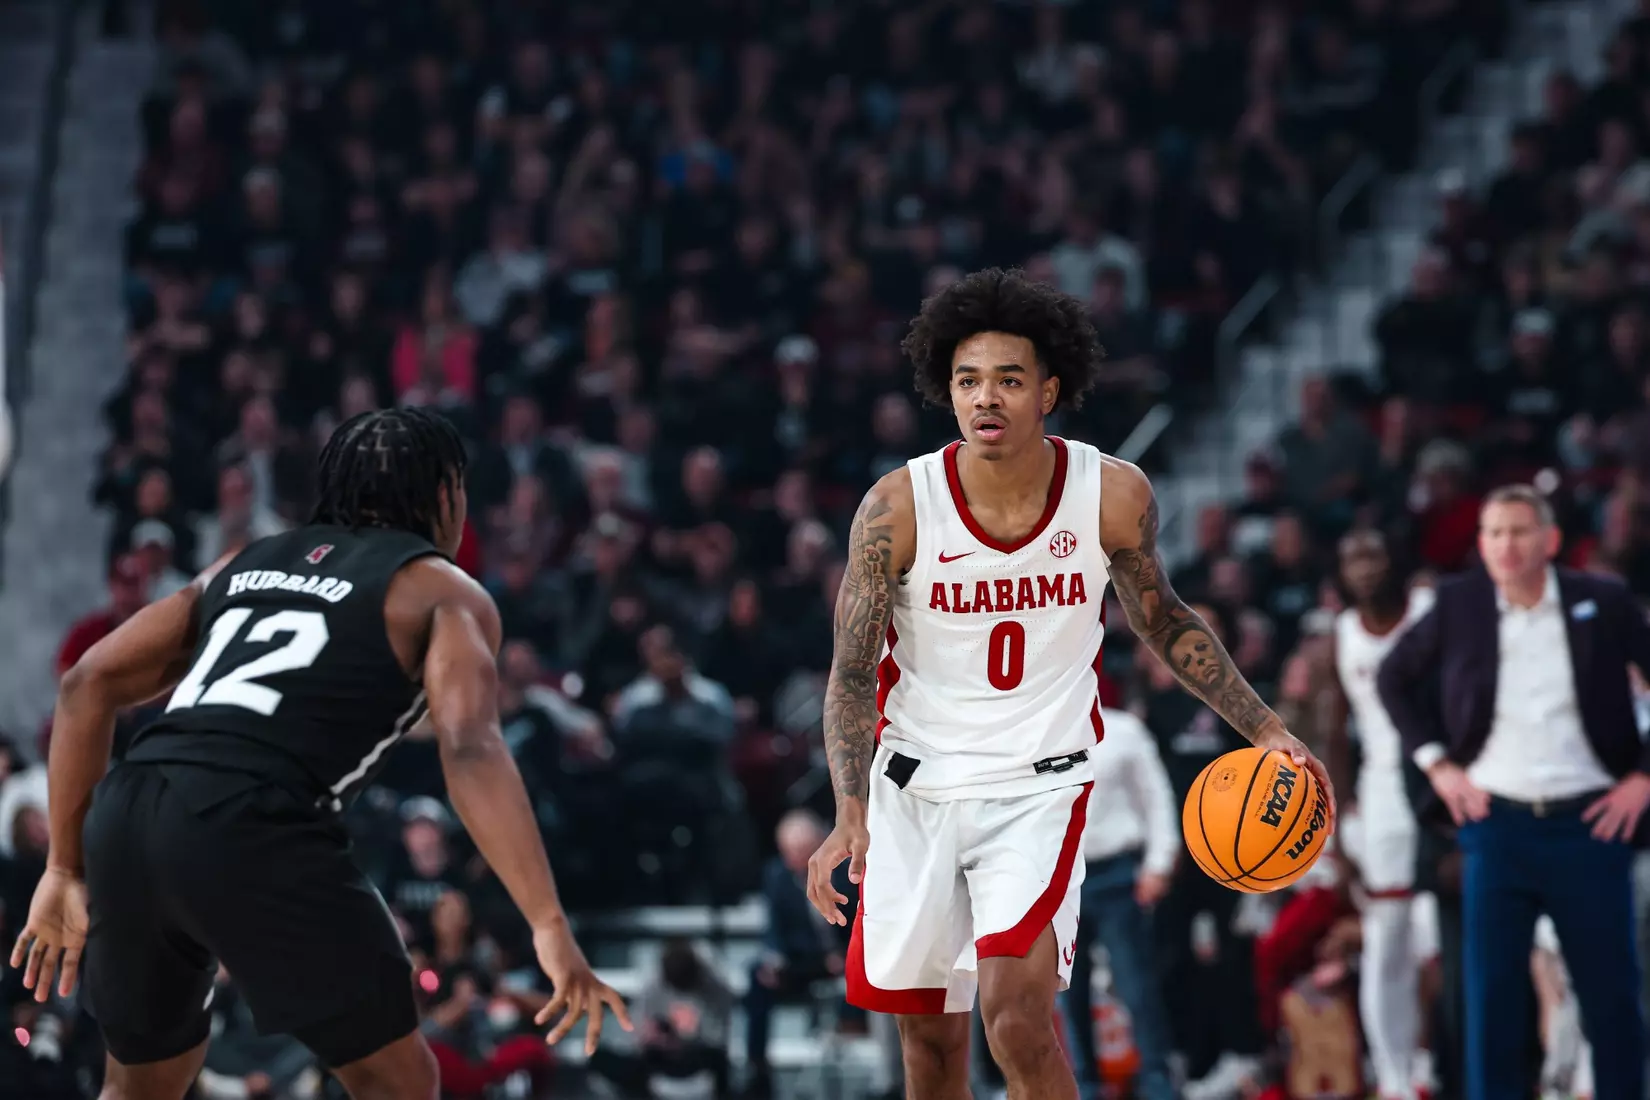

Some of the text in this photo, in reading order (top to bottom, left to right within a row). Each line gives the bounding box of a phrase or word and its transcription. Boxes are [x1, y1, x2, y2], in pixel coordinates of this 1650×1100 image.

[1050, 530, 1076, 558] SEC
[226, 570, 353, 603] HUBBARD
[929, 572, 1087, 613] ALABAMA
[164, 607, 330, 716] 12
[987, 620, 1025, 691] 0
[1260, 764, 1297, 828] NCAA
